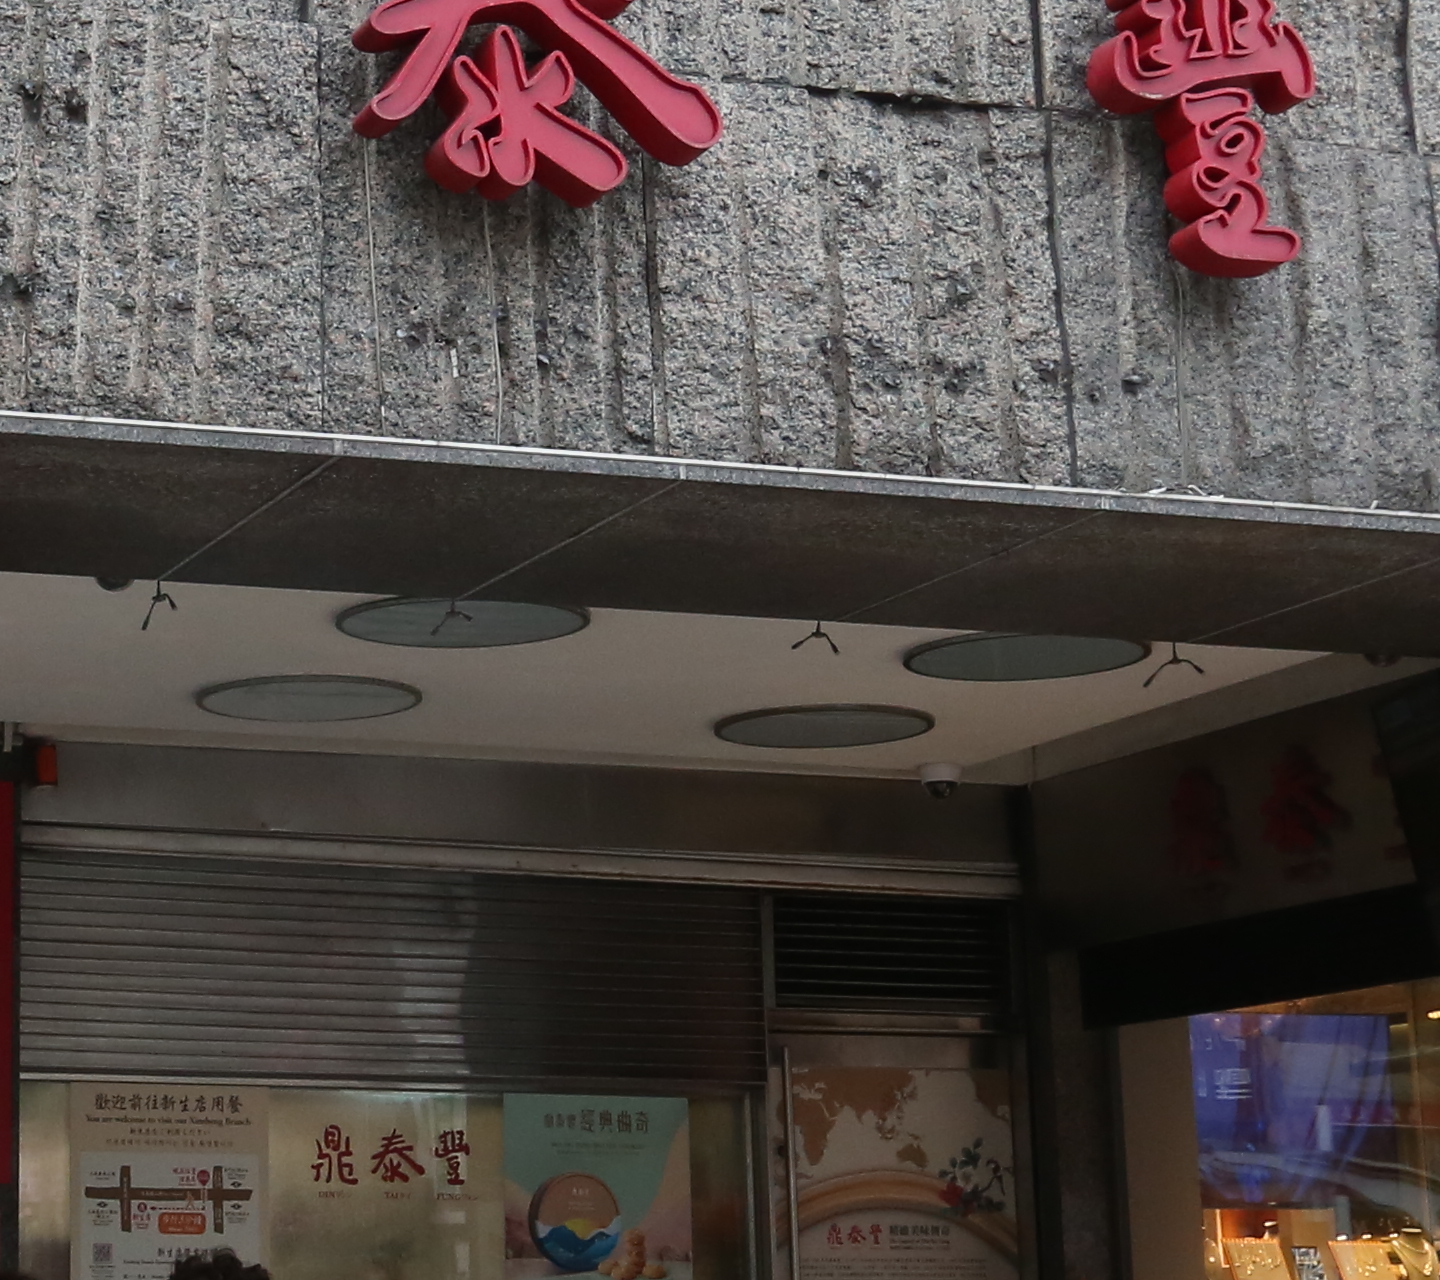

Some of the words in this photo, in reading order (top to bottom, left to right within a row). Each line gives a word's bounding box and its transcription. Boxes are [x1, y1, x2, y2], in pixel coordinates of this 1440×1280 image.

[311, 1124, 470, 1185] 鼎泰豐
[827, 1223, 882, 1245] 鼎泰豐
